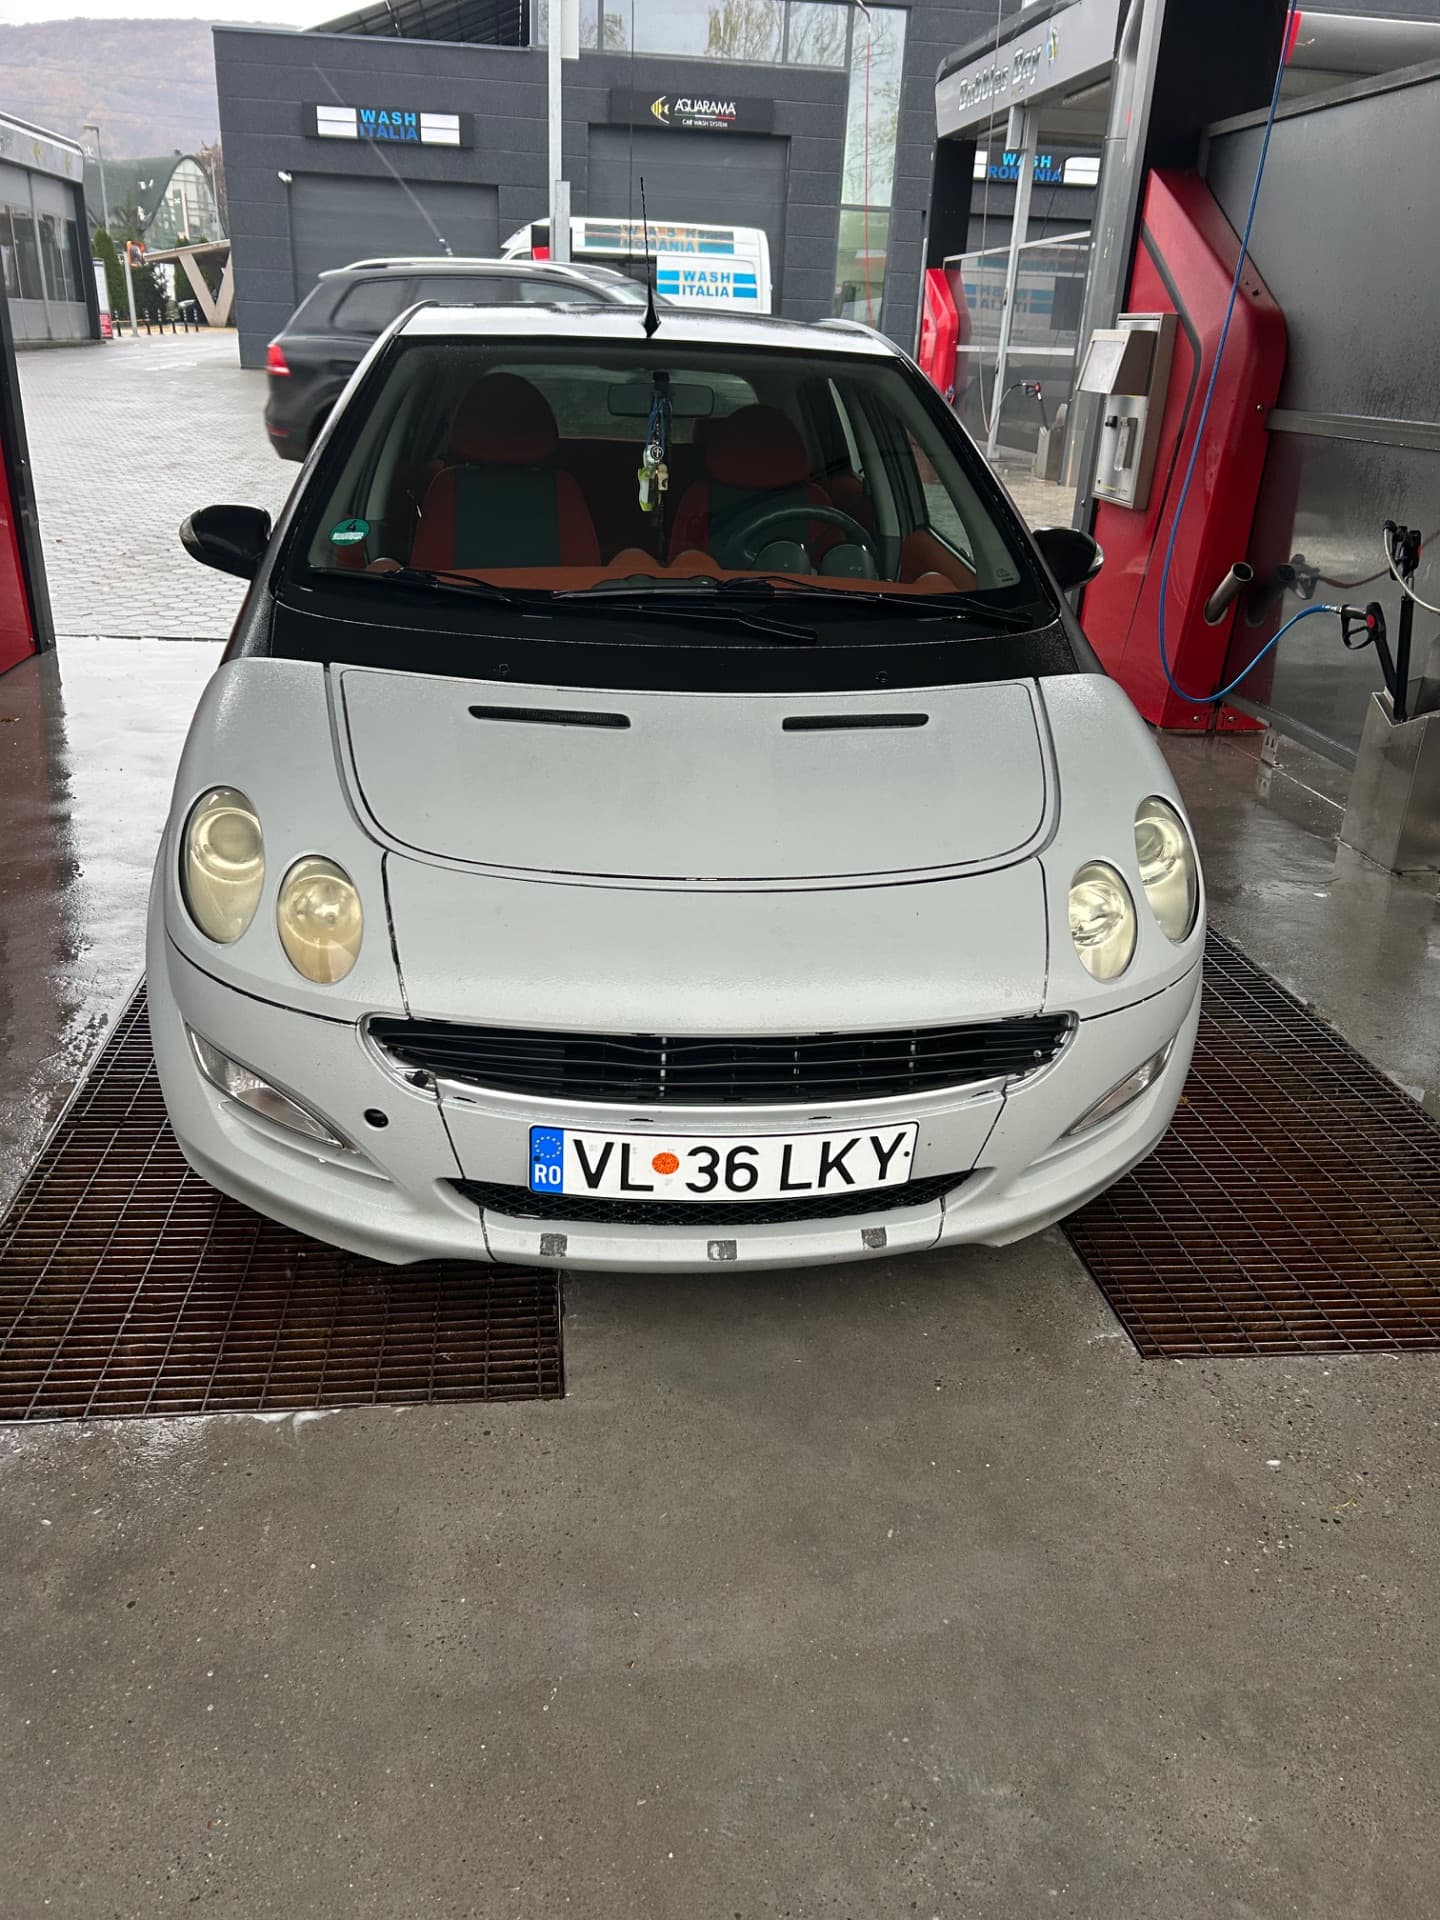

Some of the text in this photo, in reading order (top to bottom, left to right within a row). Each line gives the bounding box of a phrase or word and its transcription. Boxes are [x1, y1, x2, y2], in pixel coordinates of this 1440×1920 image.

[1012, 45, 1042, 85] Bay
[674, 98, 736, 115] AQUARAMA
[360, 109, 417, 126] WASH
[359, 123, 418, 141] ITALIA
[1002, 153, 1052, 168] WSH
[988, 165, 1062, 182] ROMNIA
[683, 270, 731, 284] WASH
[682, 285, 730, 298] ITALIA
[573, 1131, 908, 1194] VL 36 LKY
[534, 1163, 562, 1185] RO
